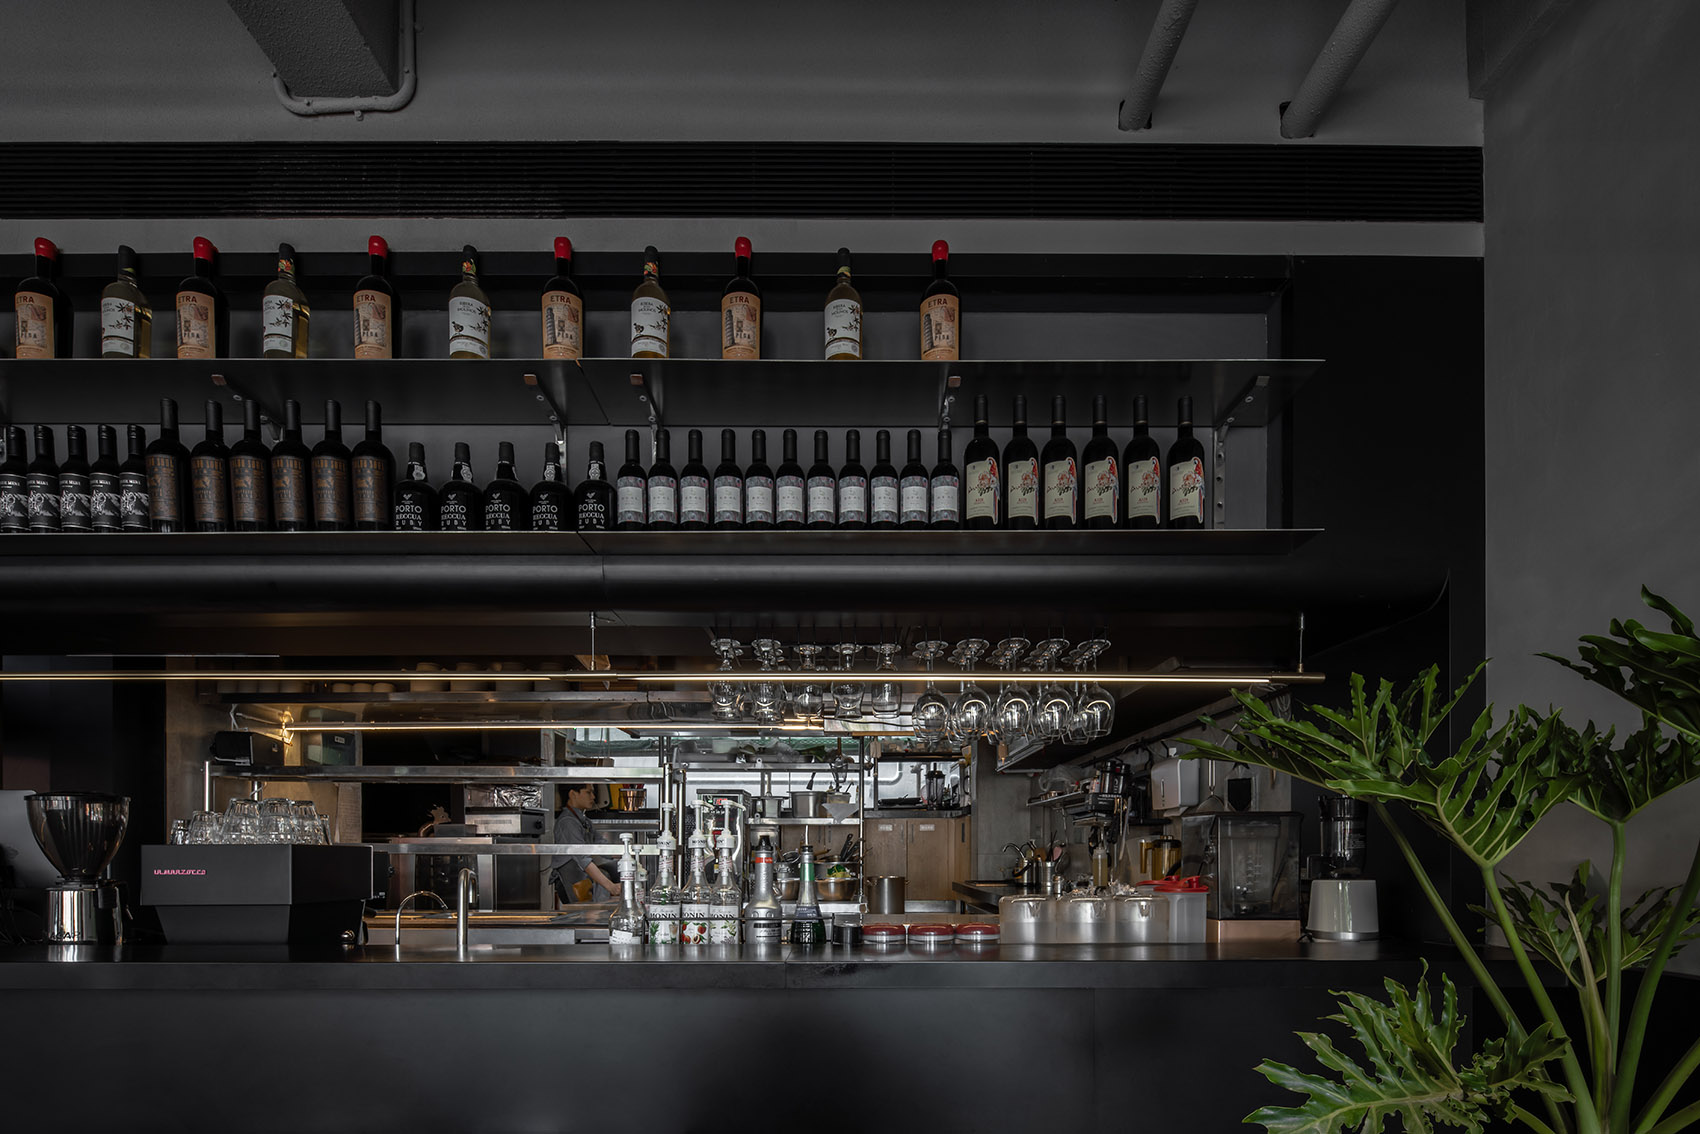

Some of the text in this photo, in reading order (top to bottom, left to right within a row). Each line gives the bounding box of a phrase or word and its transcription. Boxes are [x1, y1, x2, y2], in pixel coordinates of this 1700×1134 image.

[356, 294, 376, 303] ETRA
[550, 295, 571, 305] ETRA
[729, 295, 750, 304] ETRA
[927, 298, 948, 308] ETRA
[395, 505, 422, 513] PORTO
[441, 505, 467, 513] PORTO
[485, 504, 511, 512] PORTO
[532, 505, 558, 513] PORTO
[578, 503, 605, 512] PORTO
